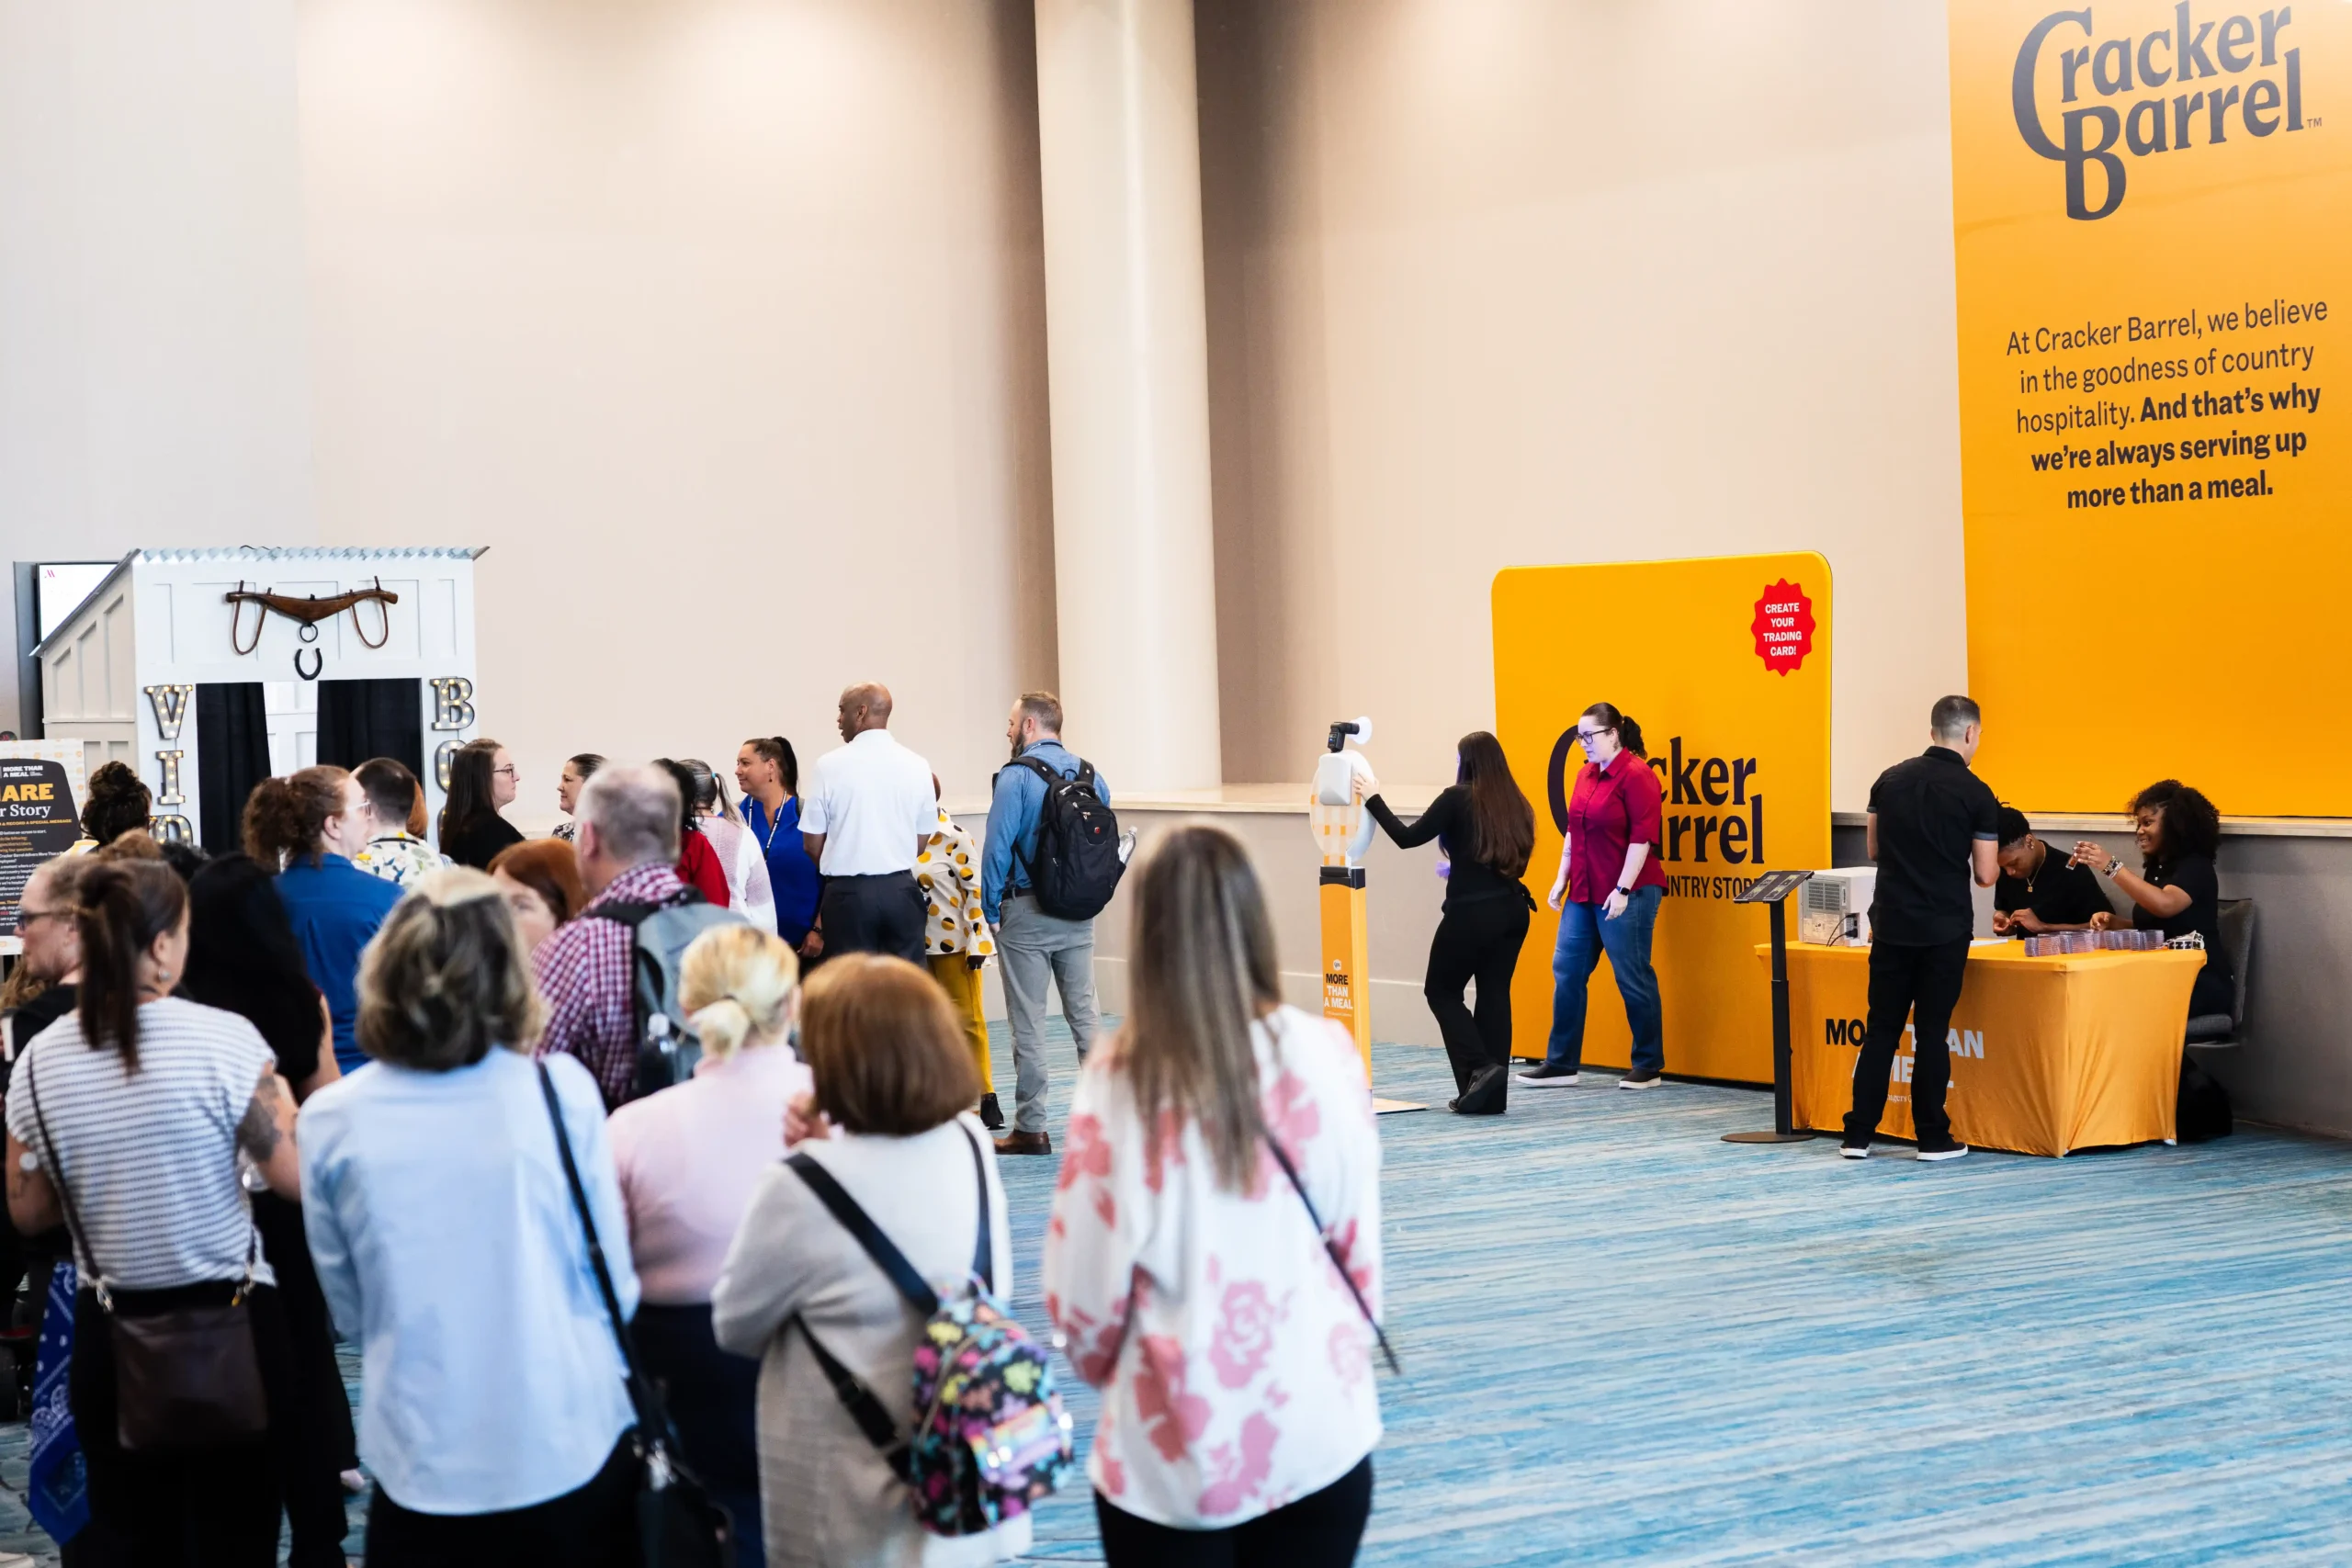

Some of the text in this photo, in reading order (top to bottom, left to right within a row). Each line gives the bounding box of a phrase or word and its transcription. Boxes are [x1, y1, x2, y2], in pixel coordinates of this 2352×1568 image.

[2012, 1, 2291, 162] Cracker
[2060, 47, 2303, 220] Barrel
[2007, 299, 2327, 355] At Cracker Barrel, we believe
[2021, 344, 2313, 393] in the goodness of country
[2018, 382, 2320, 435] hospitality. And that’s why
[2031, 430, 2306, 471] we’re always serving up
[2068, 469, 2273, 508] more than a meal.
[1765, 603, 1800, 614] CREATE
[1770, 617, 1794, 627] YOUR
[1763, 631, 1802, 642] TRADING
[1770, 646, 1796, 656] CARD!
[0, 783, 54, 802] ARE
[1547, 724, 1756, 838] Ccker
[9, 804, 51, 818] Story
[1657, 794, 1765, 864] rrel
[1326, 973, 1349, 985] MORE
[1327, 985, 1348, 998] THAN
[1324, 997, 1353, 1010] A MEAL
[1826, 1019, 1984, 1059] MO TAN
